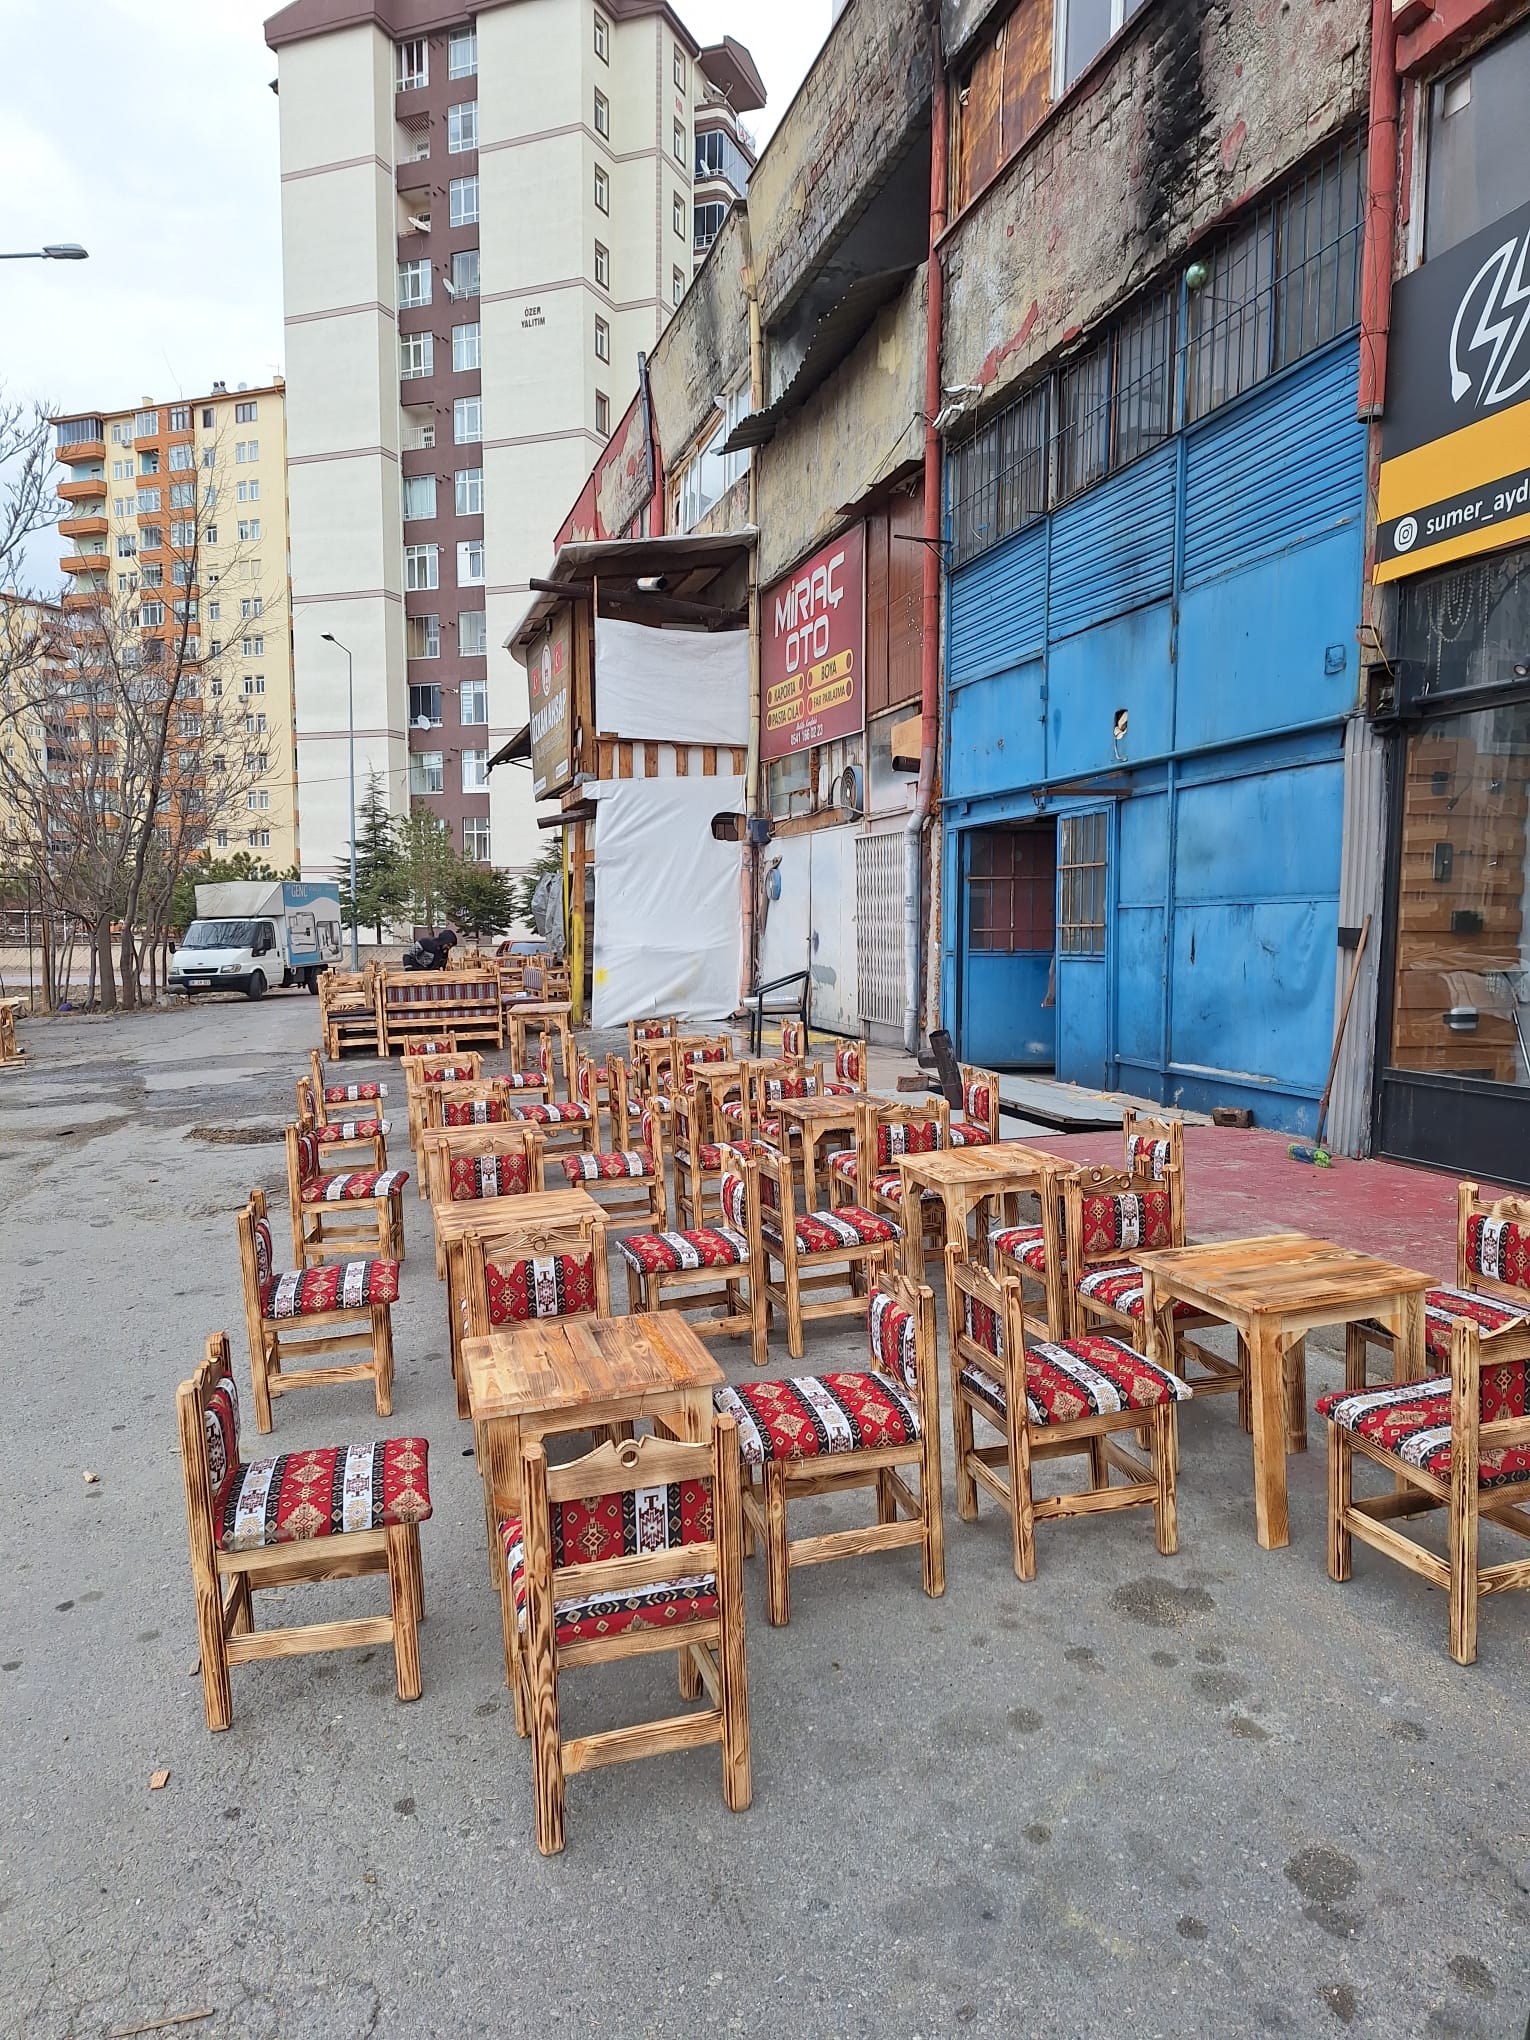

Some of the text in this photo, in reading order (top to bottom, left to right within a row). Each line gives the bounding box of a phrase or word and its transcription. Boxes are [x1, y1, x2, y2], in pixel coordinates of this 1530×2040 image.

[524, 306, 542, 317] ÖZER
[520, 317, 546, 329] YALITIM
[785, 613, 830, 673] OTO
[821, 660, 837, 680] BOYA
[774, 681, 796, 703] KAPORTA
[771, 709, 787, 727] PASTA
